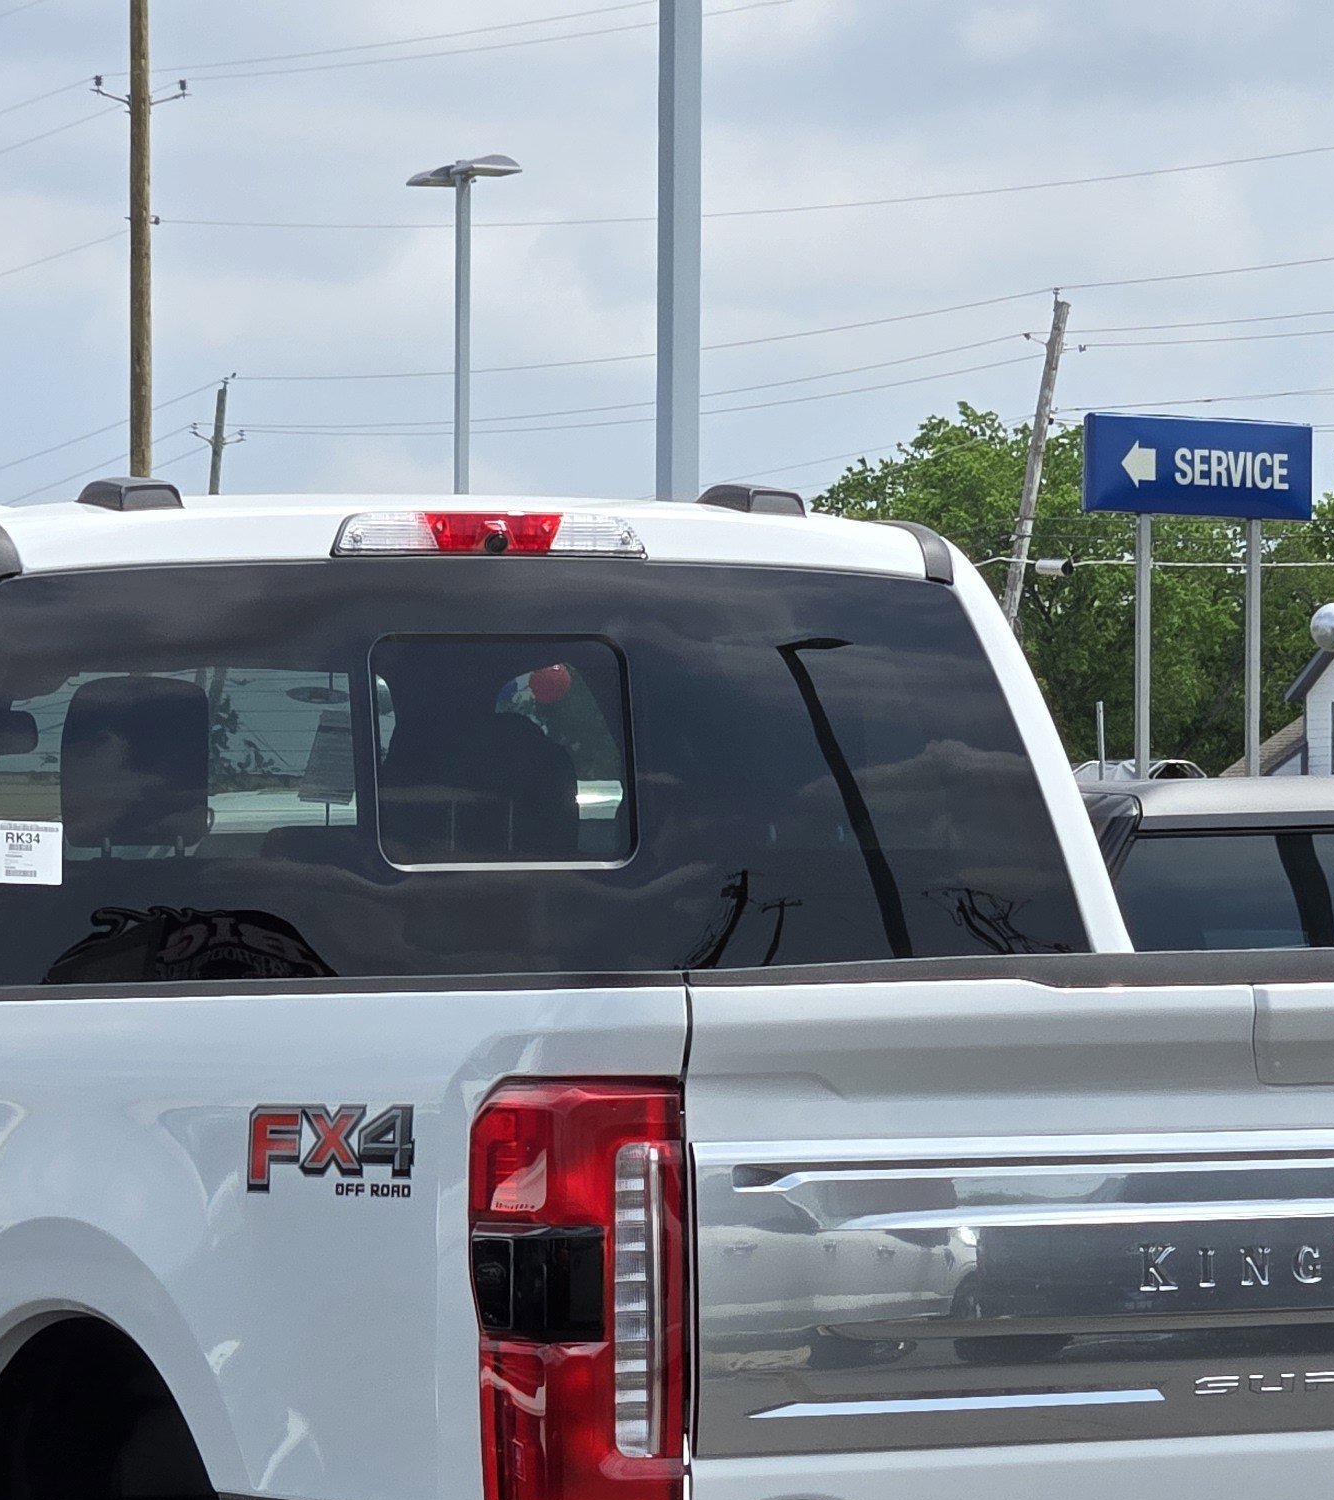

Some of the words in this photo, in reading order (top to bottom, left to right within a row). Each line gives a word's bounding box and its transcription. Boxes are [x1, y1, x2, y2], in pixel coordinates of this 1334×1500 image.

[1174, 447, 1289, 490] SERVICE
[5, 832, 41, 844] RK34
[247, 1103, 415, 1194] FX4
[335, 1183, 365, 1196] OFF
[370, 1184, 411, 1198] ROAD
[1139, 1243, 1323, 1292] KING
